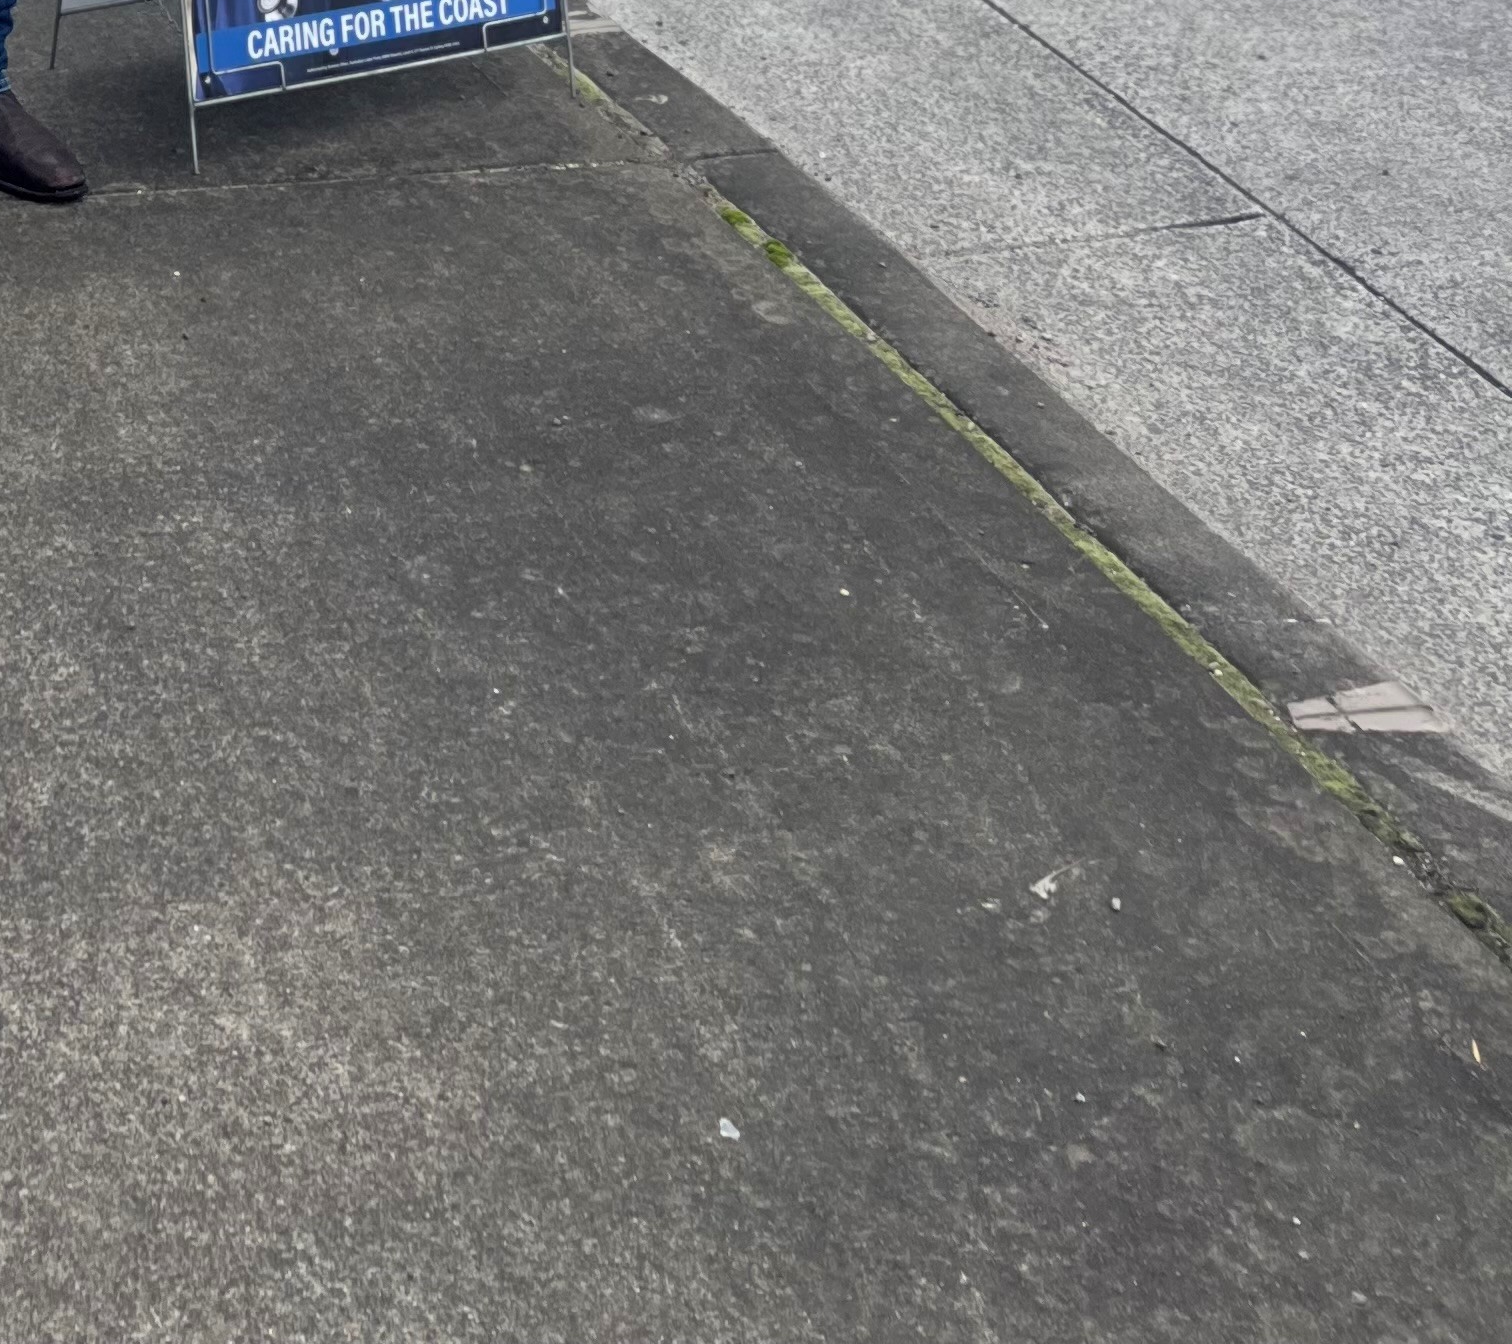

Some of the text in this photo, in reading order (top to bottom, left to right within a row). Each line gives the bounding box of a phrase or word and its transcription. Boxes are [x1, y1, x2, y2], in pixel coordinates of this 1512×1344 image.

[247, 21, 336, 59] CARING
[341, 9, 386, 43] FOR
[390, 0, 434, 34] THE
